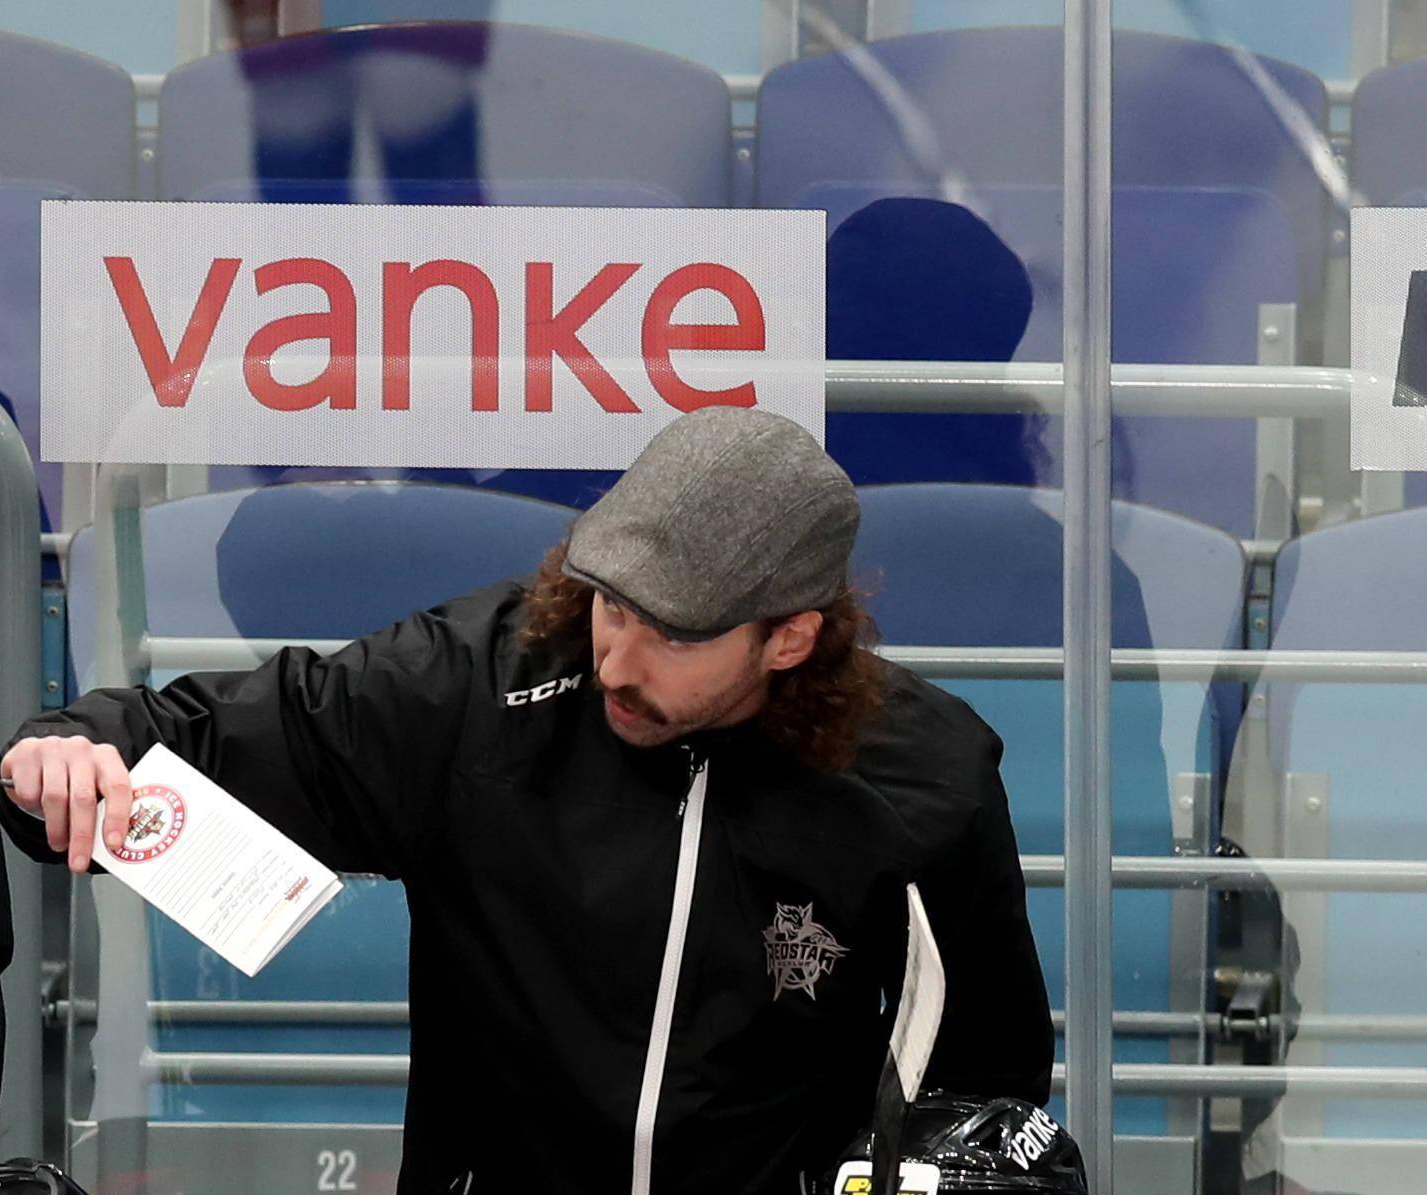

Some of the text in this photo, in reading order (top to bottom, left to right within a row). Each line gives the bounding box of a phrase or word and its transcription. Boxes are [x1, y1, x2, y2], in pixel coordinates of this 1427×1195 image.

[103, 257, 767, 415] vanke
[504, 673, 583, 706] CCM
[1009, 1107, 1060, 1171] vanke
[317, 1150, 357, 1191] 22
